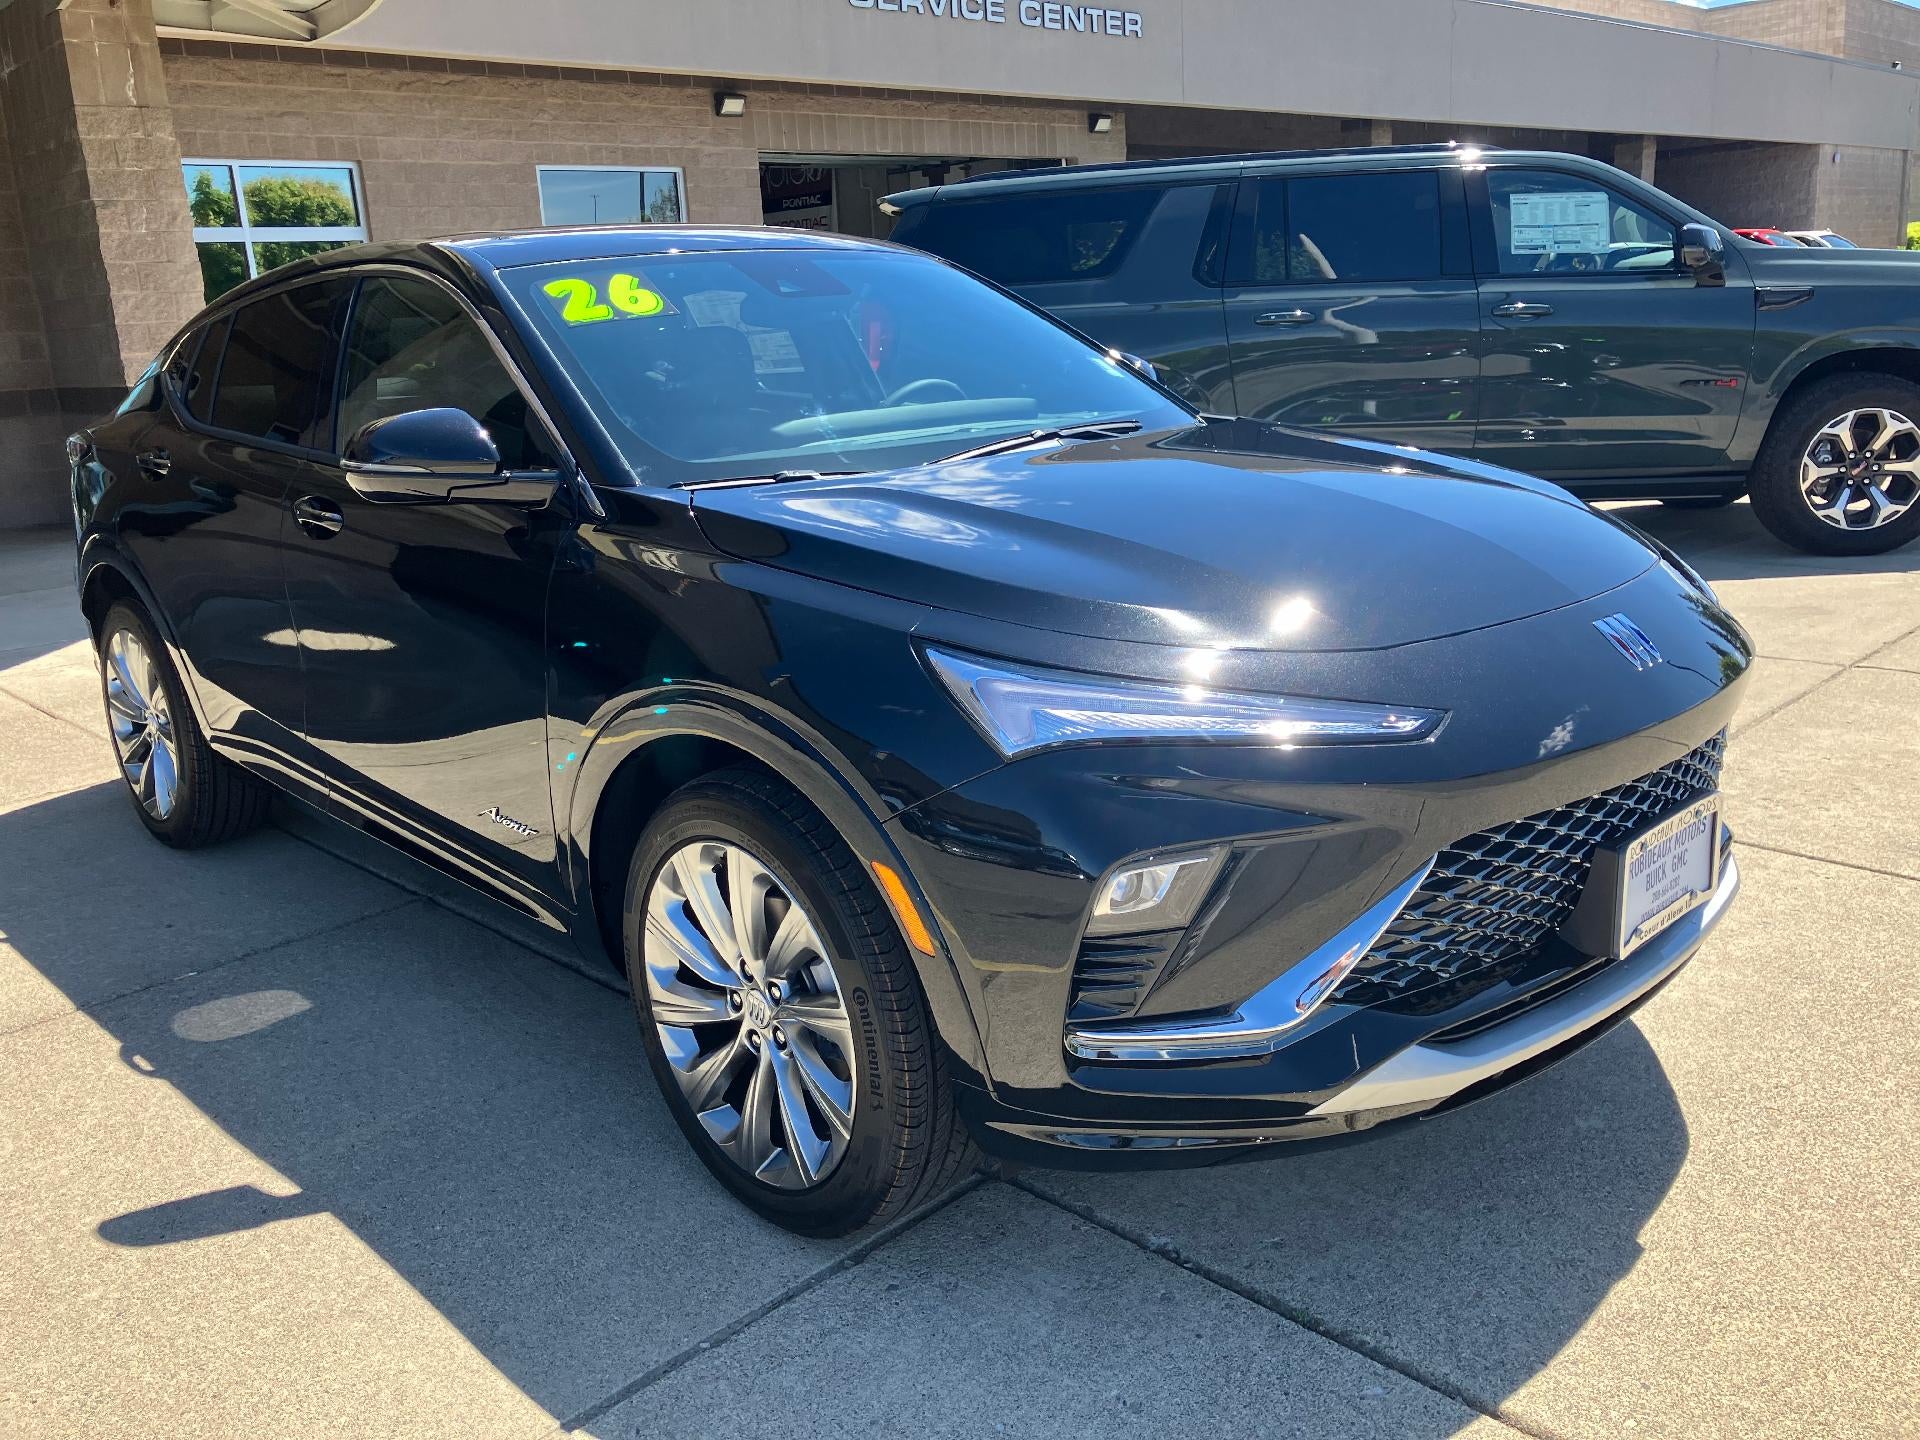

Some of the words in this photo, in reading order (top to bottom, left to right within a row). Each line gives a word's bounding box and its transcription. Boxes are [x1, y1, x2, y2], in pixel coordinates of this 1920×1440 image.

[1018, 1, 1143, 38] CENTER
[783, 195, 821, 208] PONTIAC
[543, 273, 665, 323] 26
[1674, 815, 1707, 850] MOTORS
[1645, 860, 1667, 892] BUICK
[1671, 849, 1688, 873] GMC
[853, 986, 884, 1099] Continental
